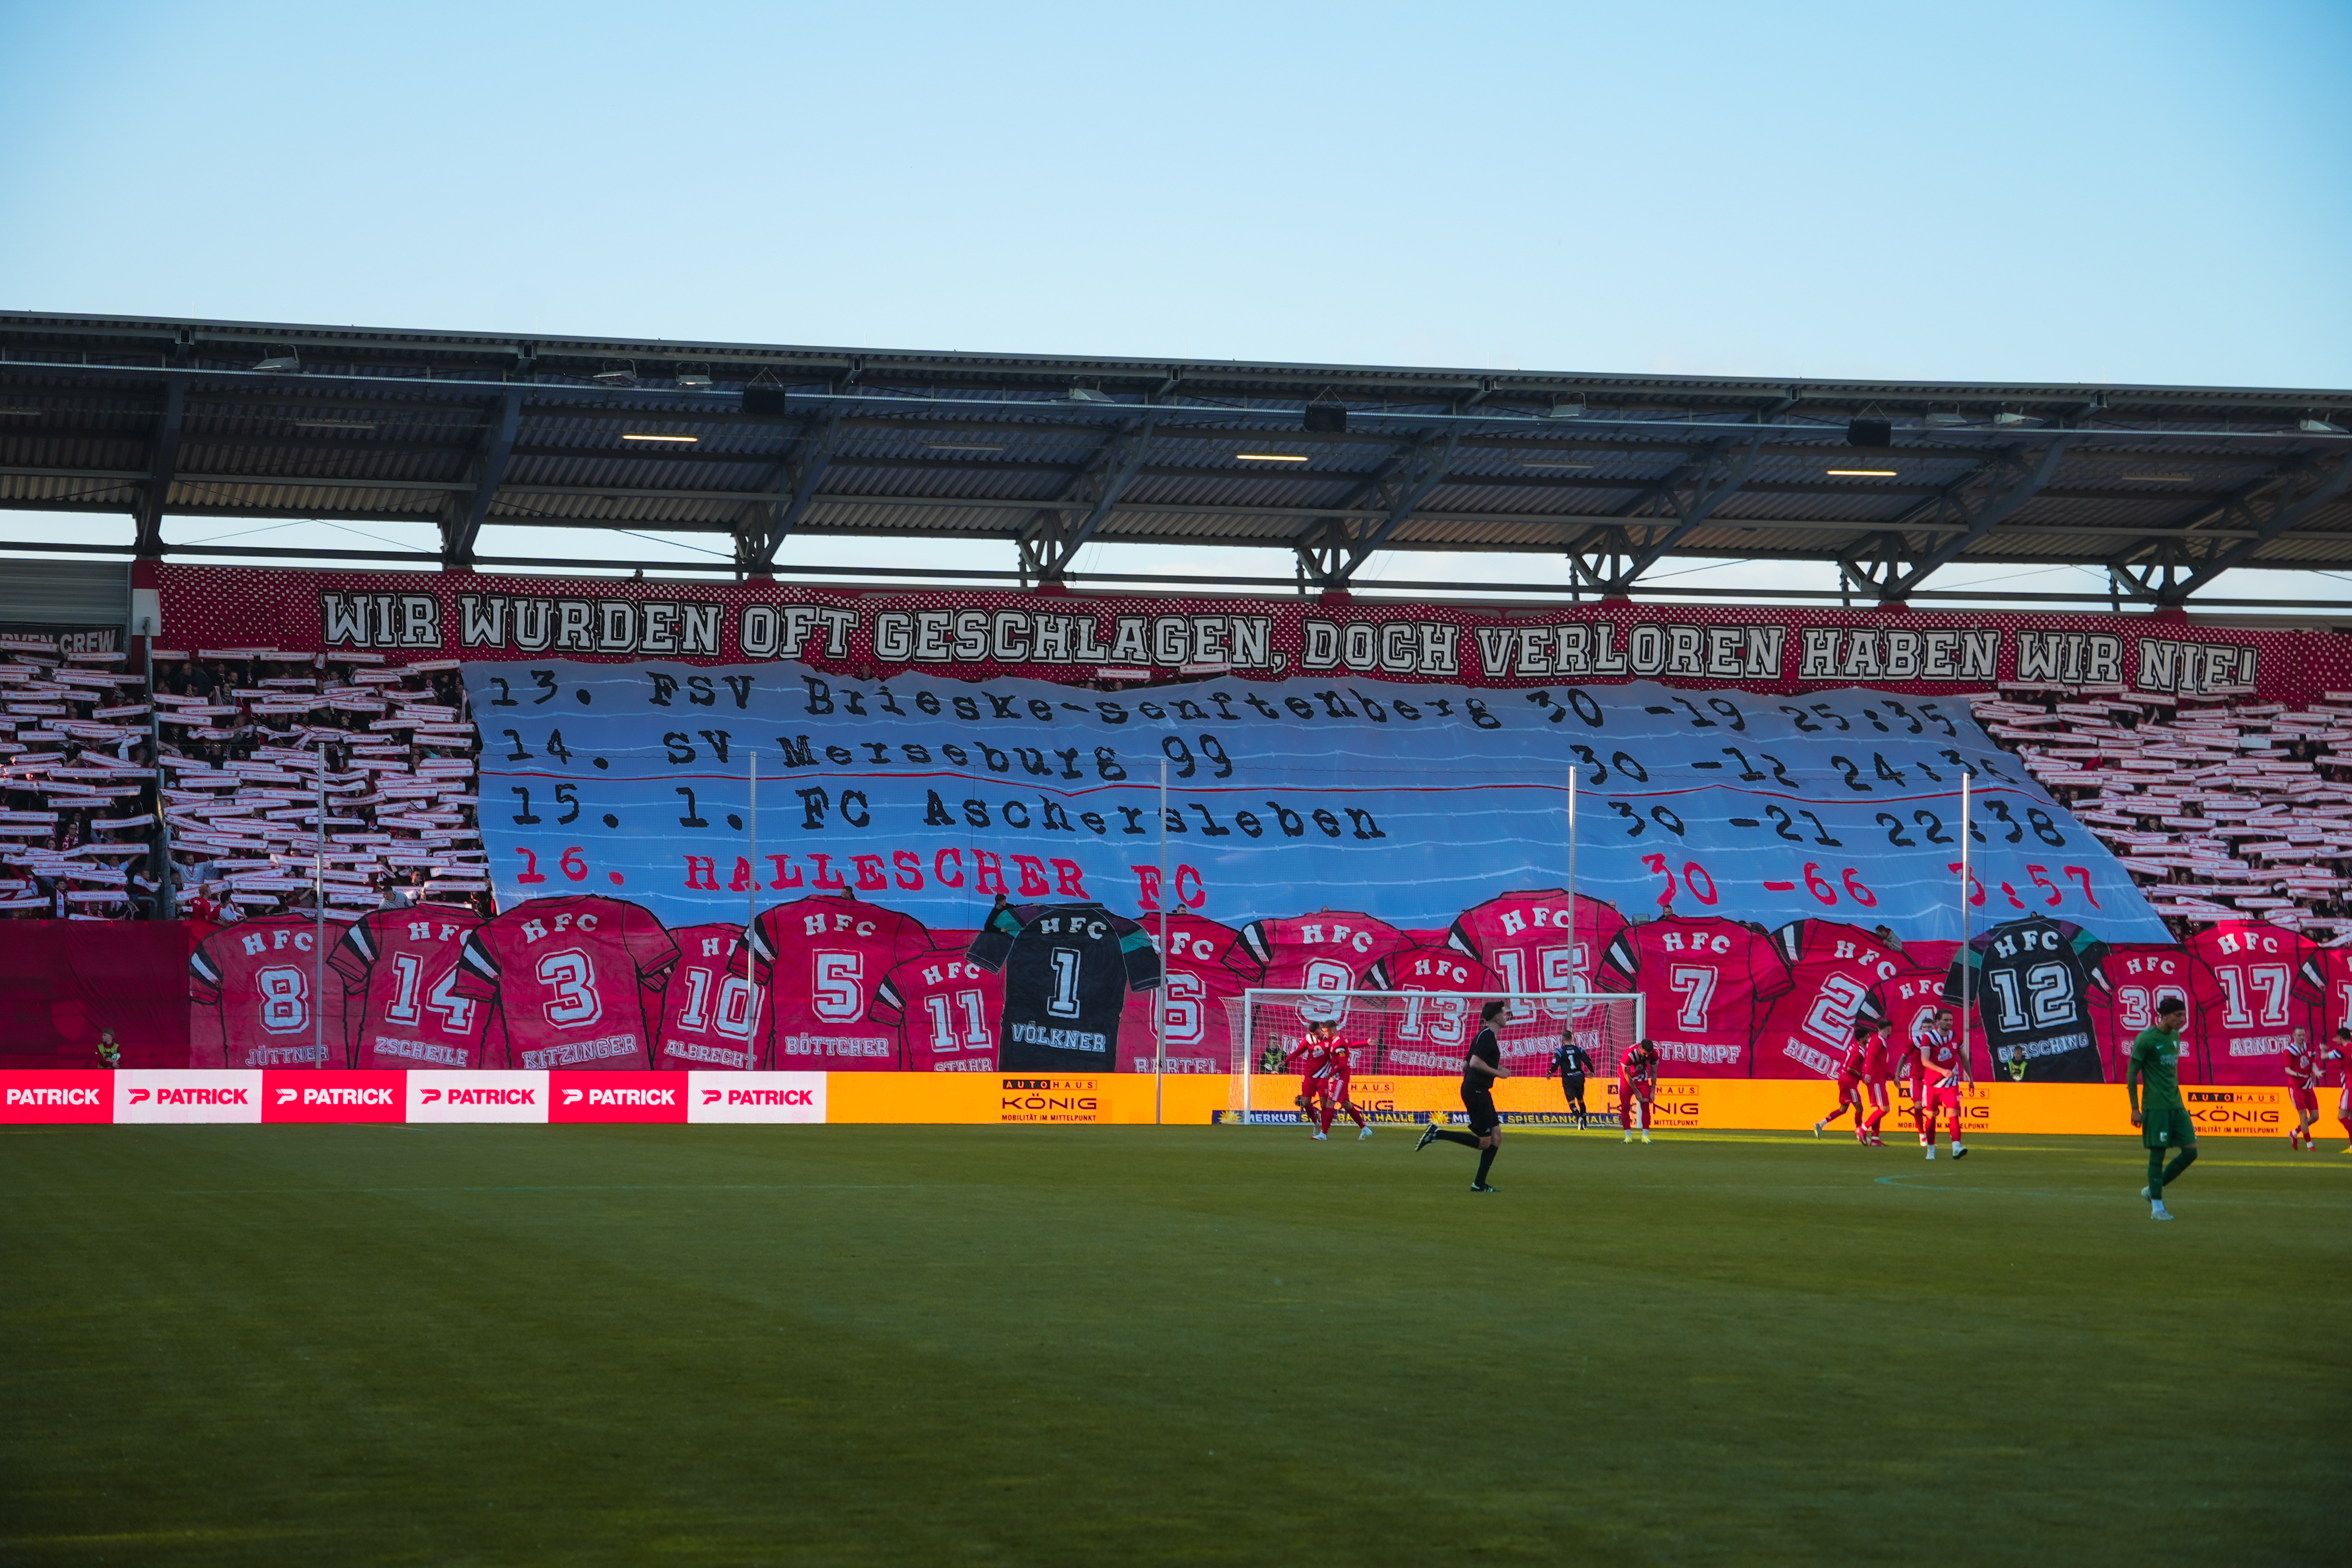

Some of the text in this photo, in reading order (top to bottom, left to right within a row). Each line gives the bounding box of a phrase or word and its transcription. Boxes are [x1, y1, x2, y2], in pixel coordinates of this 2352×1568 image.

[321, 593, 2259, 694] WIR WURDEN OFT GESCHLAGEN, DOCH VERLOREN HABEN WIR NIE!
[491, 670, 591, 706] 13.
[646, 671, 755, 709] FSV
[1527, 688, 1603, 728] 30
[1779, 700, 1956, 737] 25:35
[502, 729, 608, 770] 14.
[664, 730, 733, 765] SV
[776, 735, 1126, 781] Merseburg
[1162, 734, 1232, 778] 99
[1570, 745, 1648, 785] 30
[512, 783, 619, 828] 15.
[676, 787, 743, 830] 1.
[795, 787, 870, 830] FC
[923, 789, 1386, 839] Aschersleben
[1608, 802, 1684, 837] 30
[516, 846, 624, 886] 16.
[683, 848, 1091, 899] HALLESCHER
[1131, 864, 1205, 910] FC
[1641, 853, 1718, 906] 30
[521, 913, 598, 943] HFC
[803, 913, 876, 937] HFC
[1040, 917, 1107, 940] HFC
[1500, 908, 1569, 936] HFC
[242, 930, 313, 955] HFC
[1301, 924, 1373, 952] HFC
[1662, 933, 1730, 954] HFC
[1994, 930, 2059, 959] HFC
[2217, 932, 2278, 955] HFC
[921, 962, 980, 985] HFC
[1415, 960, 1467, 984] HFC
[1834, 940, 1896, 979] HFC
[2126, 957, 2176, 975] HFC
[385, 951, 476, 1035] 14
[535, 947, 602, 1030] 3
[812, 948, 864, 1023] 5
[1047, 947, 1081, 1019] 1
[1295, 958, 1356, 1031] 9
[1493, 943, 1592, 1025] 15
[1671, 963, 1718, 1032] 7
[1899, 979, 1945, 1000] HFC
[1989, 961, 2077, 1033] 12
[2214, 962, 2291, 1030] 17
[255, 965, 309, 1035] 8
[677, 966, 765, 1041] 10
[1149, 968, 1206, 1045] 6
[1802, 971, 1869, 1050] 2
[924, 989, 993, 1052] 11
[1397, 985, 1470, 1046] 13
[374, 1036, 468, 1067] ZSCHEILE
[522, 1034, 638, 1069] KITZINGER
[785, 1033, 889, 1057] BÖTTCHER
[1012, 1021, 1106, 1053] VÖLKNER
[245, 1045, 328, 1067] JÜTTNER
[1567, 1054, 1577, 1070] 1
[7, 1089, 100, 1106] PATRICK
[157, 1088, 249, 1105] PATRICK
[304, 1088, 394, 1105] PATRICK
[448, 1089, 535, 1105] PATRICK
[589, 1089, 676, 1106] PATRICK
[728, 1090, 813, 1106] PATRICK
[1006, 1081, 1093, 1089] AUTOHAUS
[1002, 1093, 1097, 1110] KÖNIG
[2189, 1106, 2278, 1122] KÖNIG
[1376, 1114, 1415, 1122] HALLE
[1508, 1115, 1577, 1123] SPIELBANK
